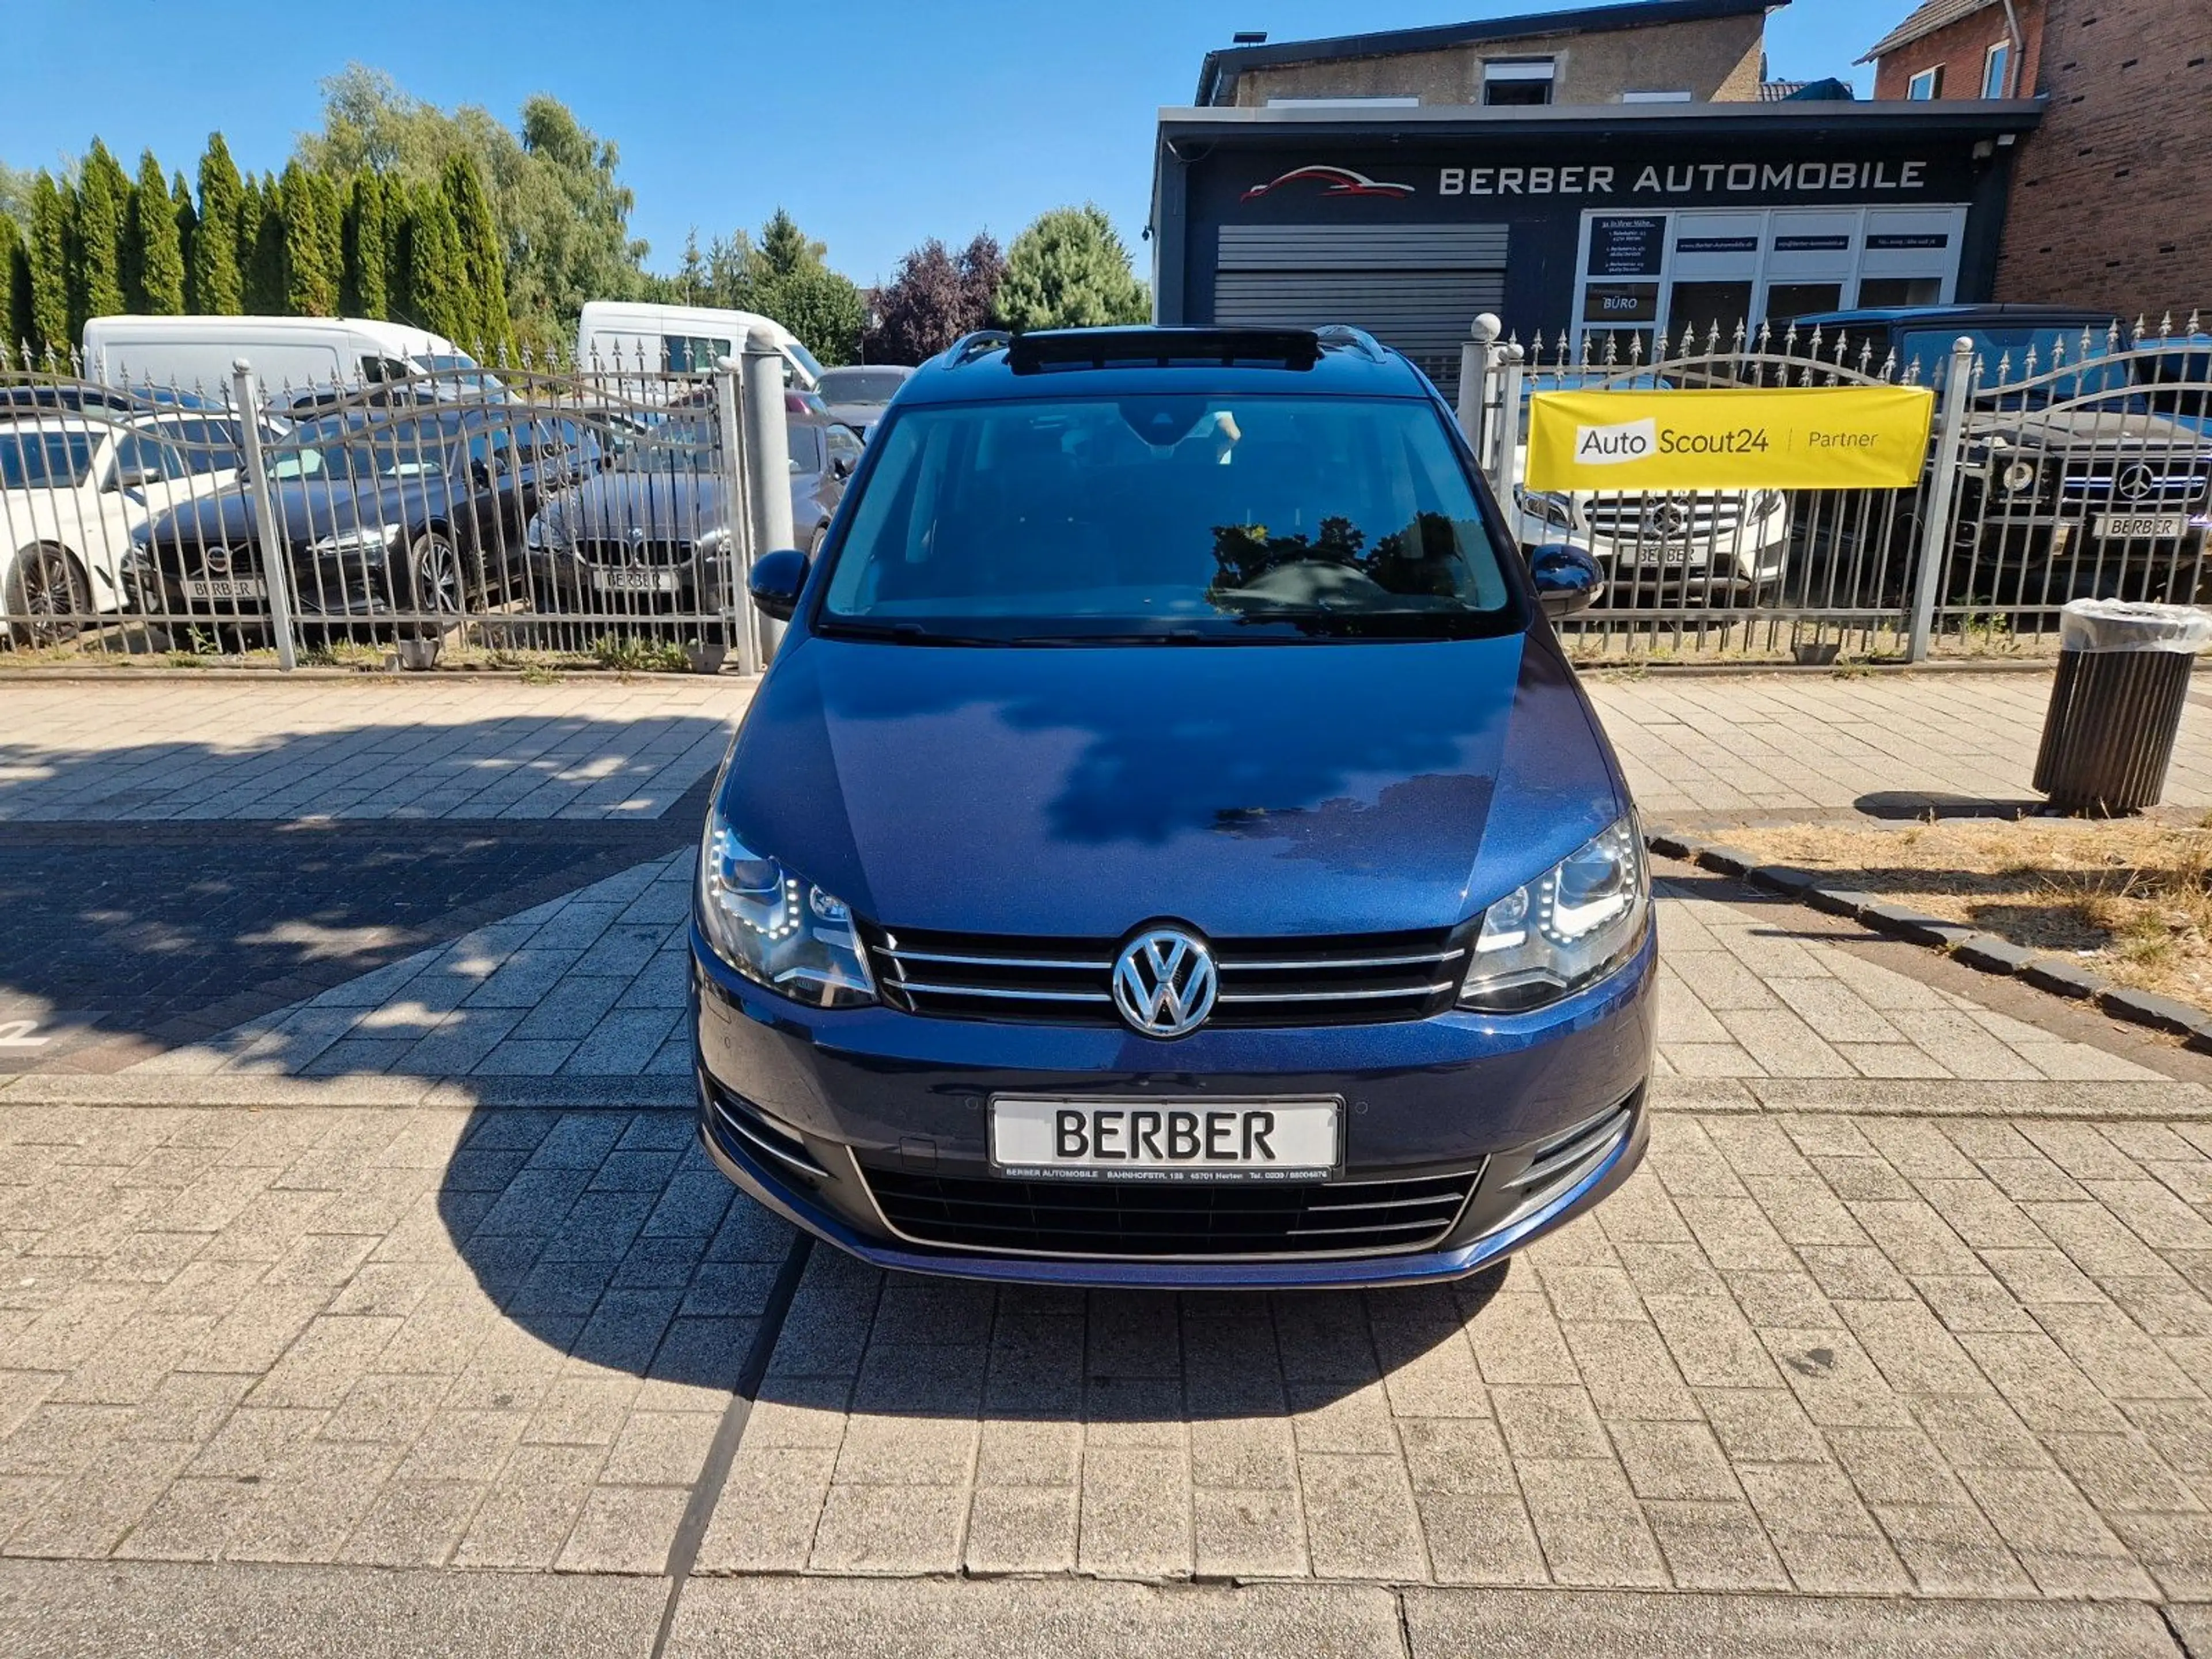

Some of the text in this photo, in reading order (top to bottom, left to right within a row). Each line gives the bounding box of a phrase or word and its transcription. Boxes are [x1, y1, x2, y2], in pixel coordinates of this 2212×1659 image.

[1439, 161, 1927, 195] BERBER AUTOMOBILE
[1603, 296, 1638, 309] BÜRO
[1580, 428, 1879, 454] Auto Scout24 Partner
[1056, 1110, 1276, 1160] BERBER
[1006, 1168, 1040, 1176] BERBER
[1043, 1168, 1098, 1178] AUTOMOBILE
